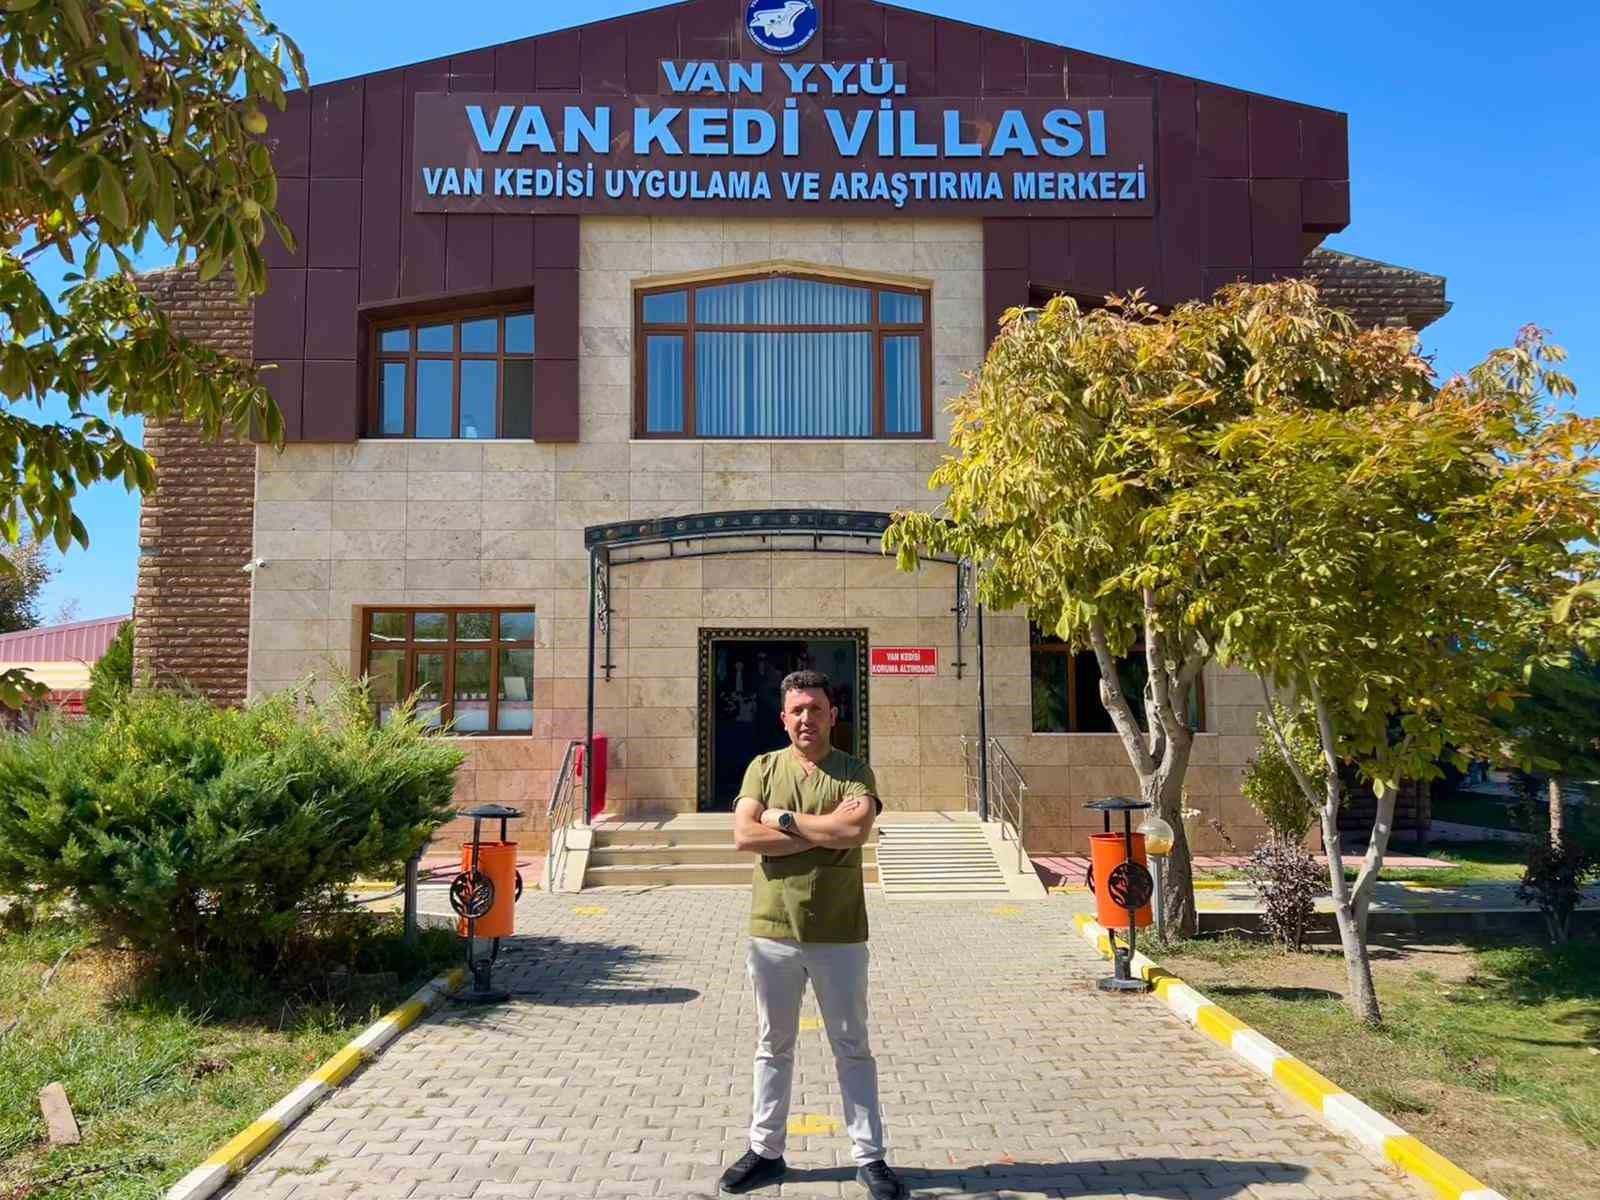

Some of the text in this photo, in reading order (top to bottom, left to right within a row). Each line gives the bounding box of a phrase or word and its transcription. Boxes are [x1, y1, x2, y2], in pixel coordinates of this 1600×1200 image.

[661, 57, 907, 95] VAN Y.Y.Ü.
[465, 97, 1106, 157] VAN KEDİ VİLLASI
[422, 161, 1146, 208] VAN KEDİSİ UYGULAMA VE ARAŞTIRMA MERKEZİ
[886, 652, 899, 661] VAN
